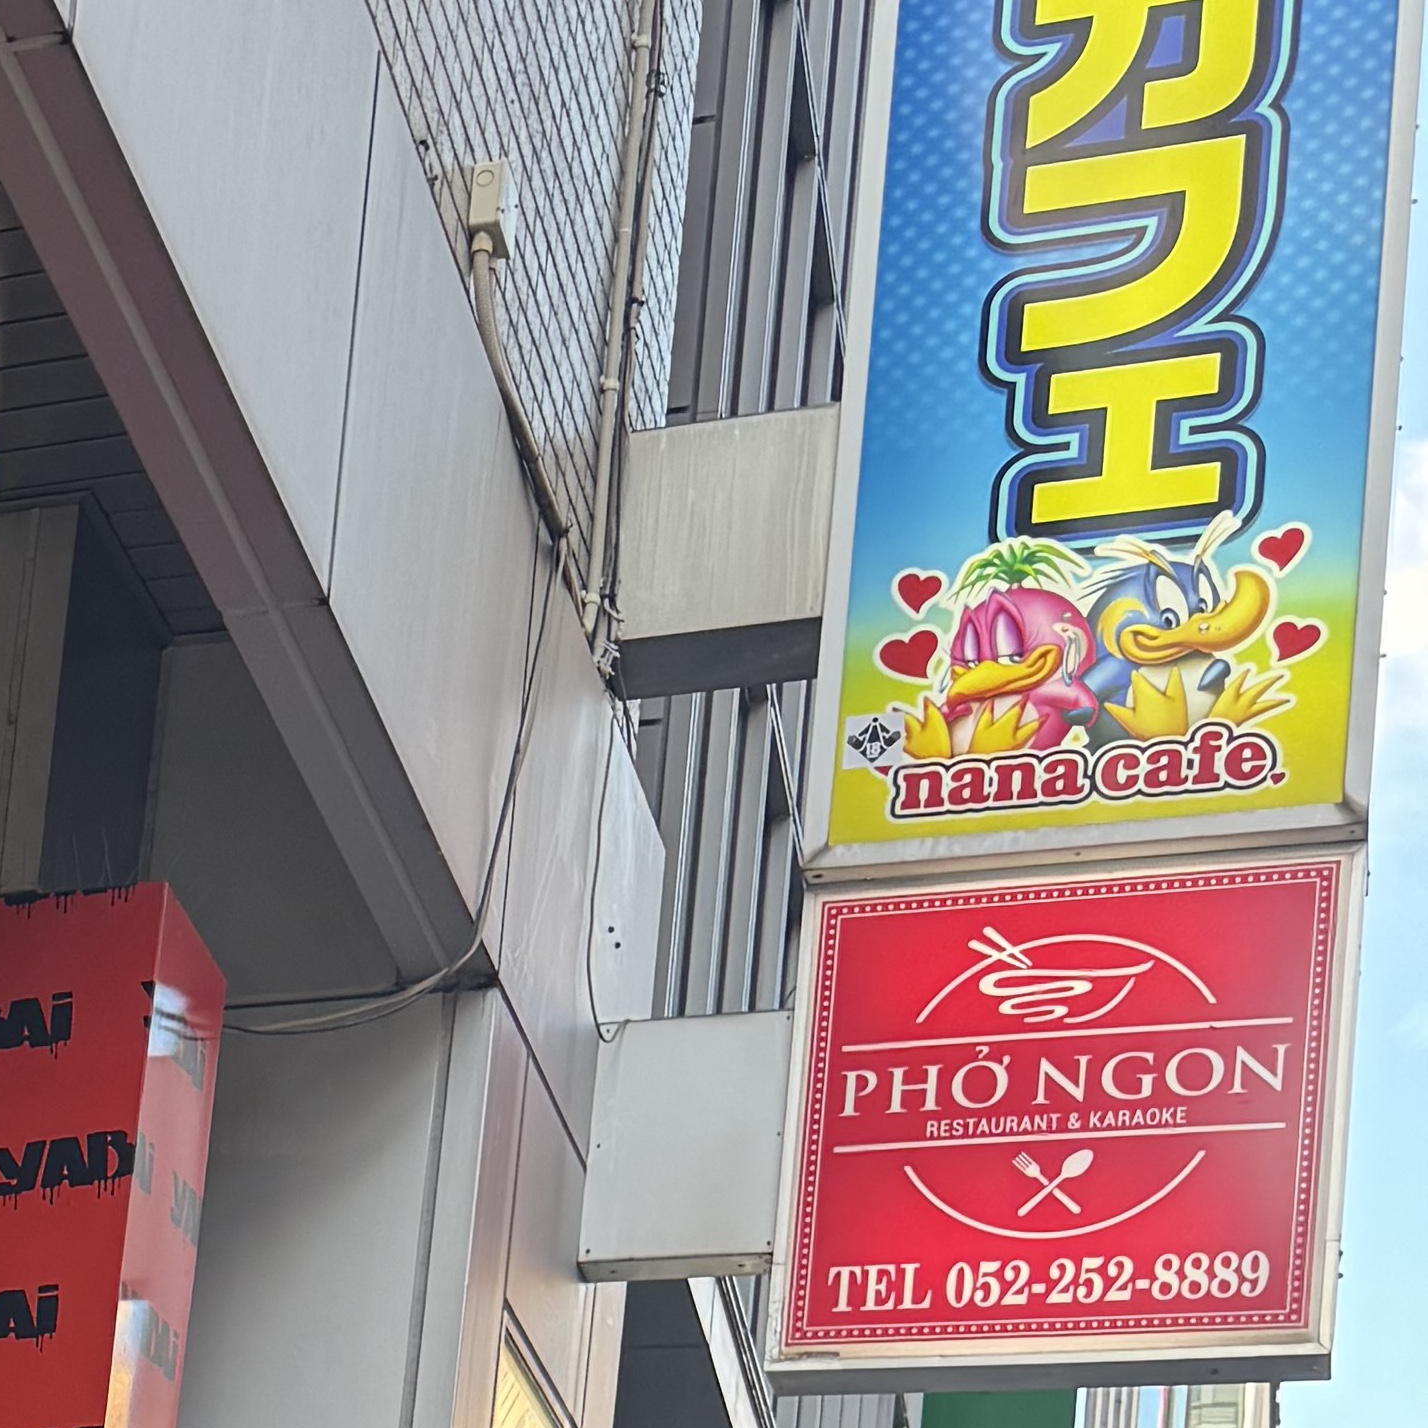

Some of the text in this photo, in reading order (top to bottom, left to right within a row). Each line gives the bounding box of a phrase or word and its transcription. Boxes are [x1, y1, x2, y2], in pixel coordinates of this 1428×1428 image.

[898, 731, 1268, 811] nana cafe
[1031, 1043, 1293, 1106] NGON
[925, 1106, 1189, 1139] RESTAURANT & KARAOKE
[828, 1250, 1271, 1313] TEL 052-252-8889
